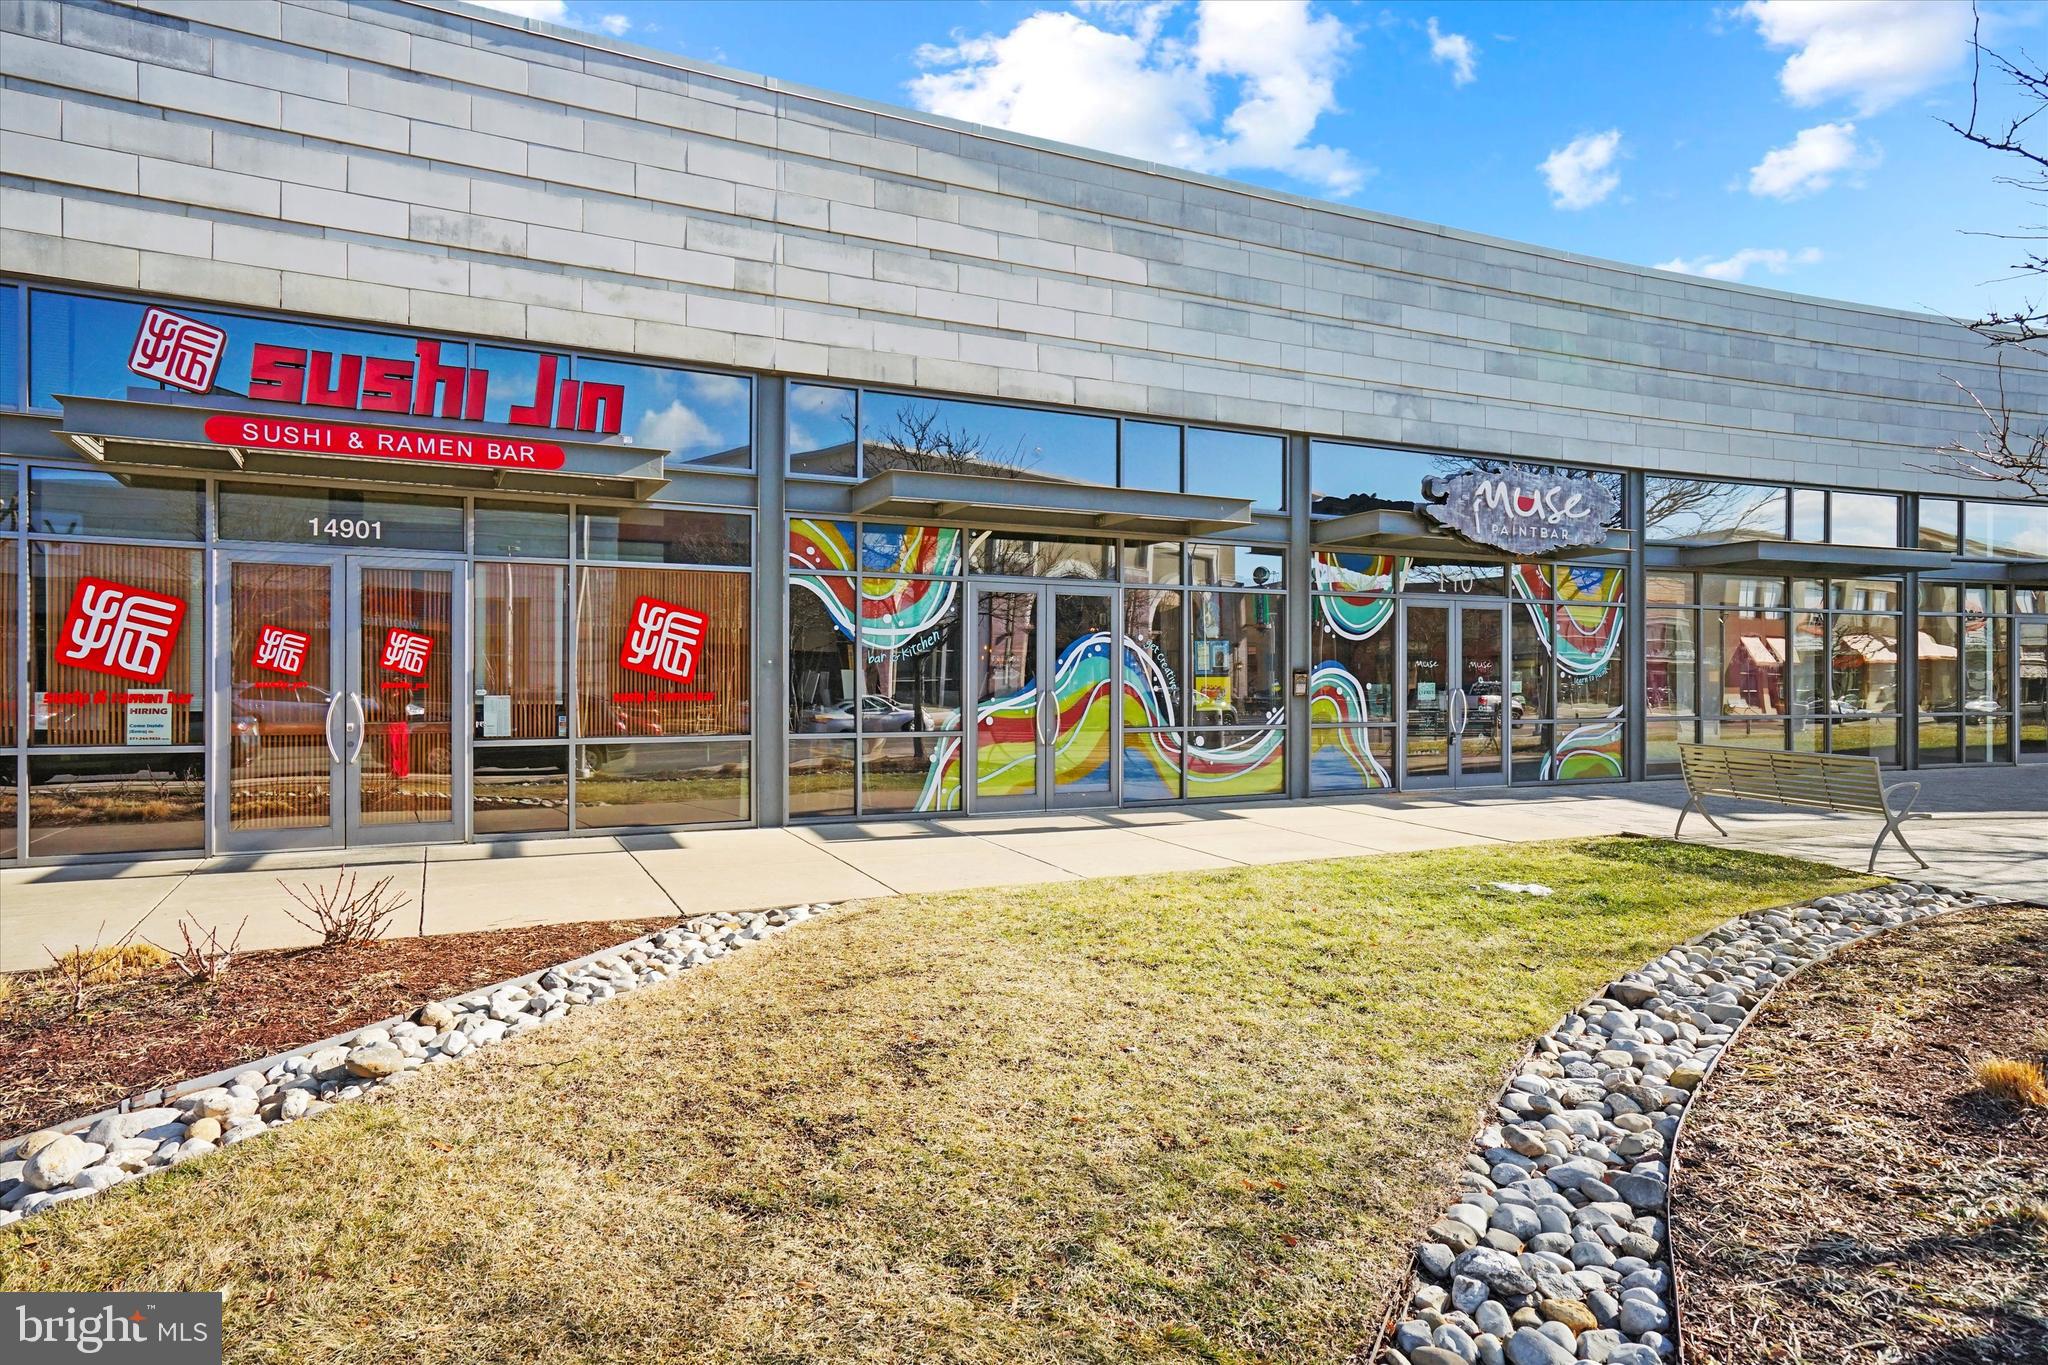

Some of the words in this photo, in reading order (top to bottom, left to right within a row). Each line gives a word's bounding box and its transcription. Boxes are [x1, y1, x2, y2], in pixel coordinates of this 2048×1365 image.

[509, 354, 625, 434] Jin
[242, 423, 331, 447] SUSHI
[348, 431, 364, 449] &
[378, 433, 472, 458] RAMEN
[487, 443, 535, 463] BAR
[308, 517, 382, 540] 14901
[1491, 524, 1569, 540] PAINTBAR
[1143, 640, 1160, 654] get
[867, 650, 887, 664] bar
